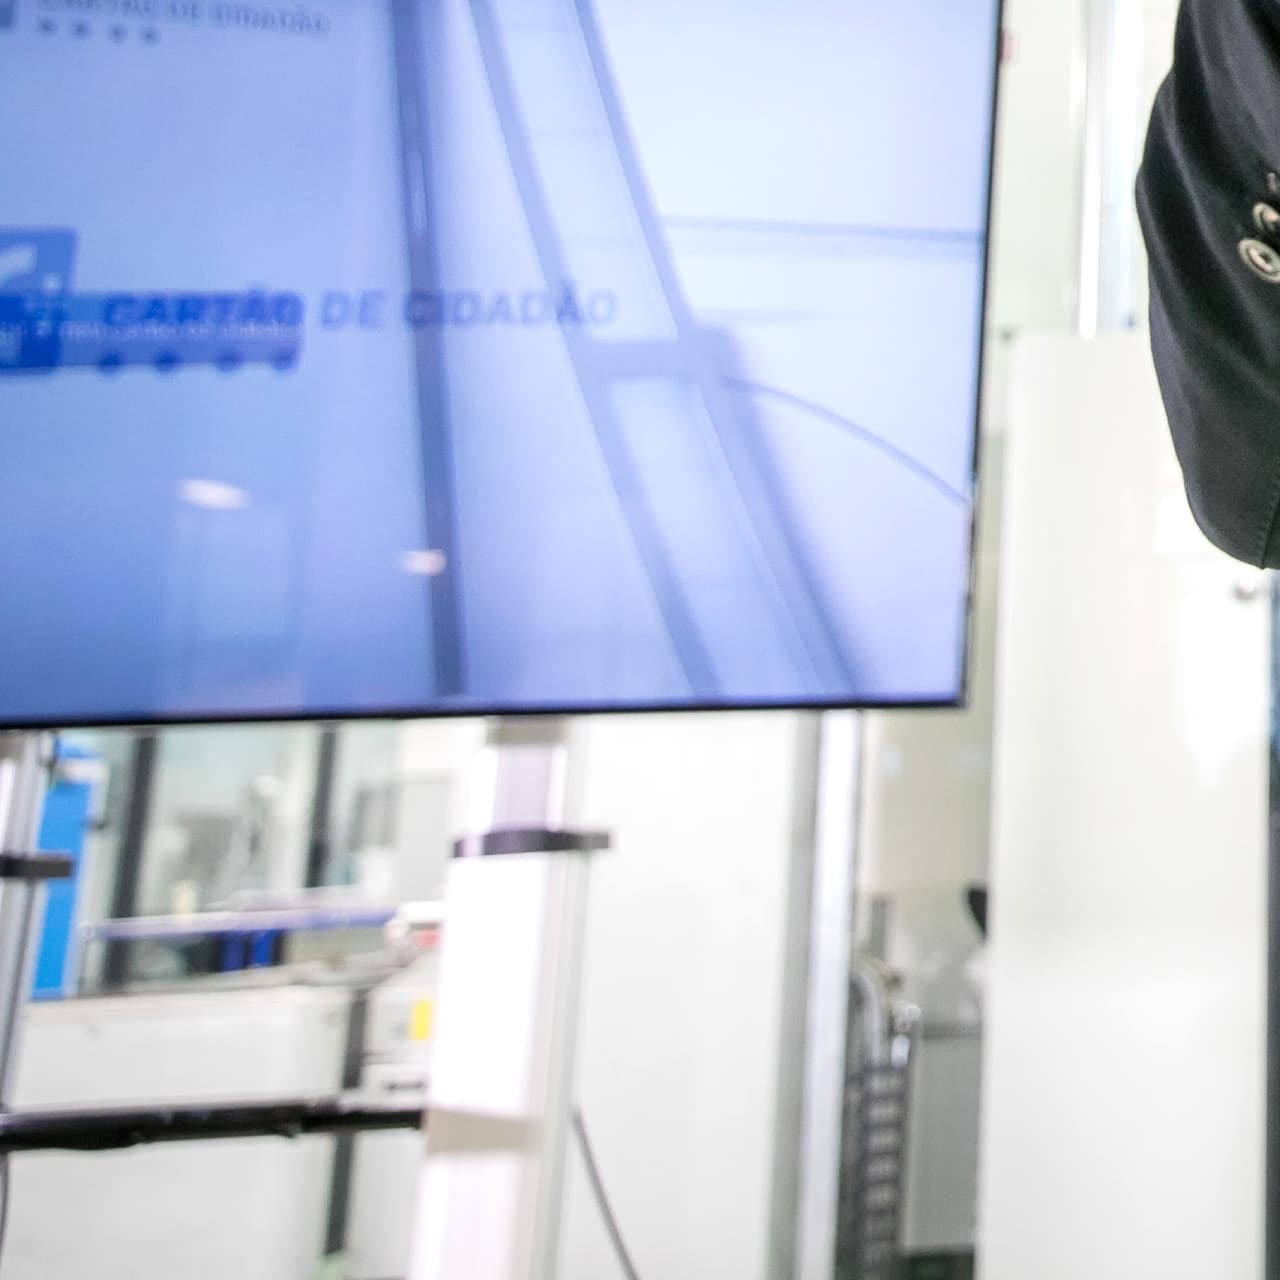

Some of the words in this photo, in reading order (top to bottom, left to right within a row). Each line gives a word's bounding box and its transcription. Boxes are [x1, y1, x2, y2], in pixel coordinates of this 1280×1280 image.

[103, 284, 304, 326] CARTÃO
[320, 291, 387, 330] DE
[403, 282, 618, 328] CIDADÃO
